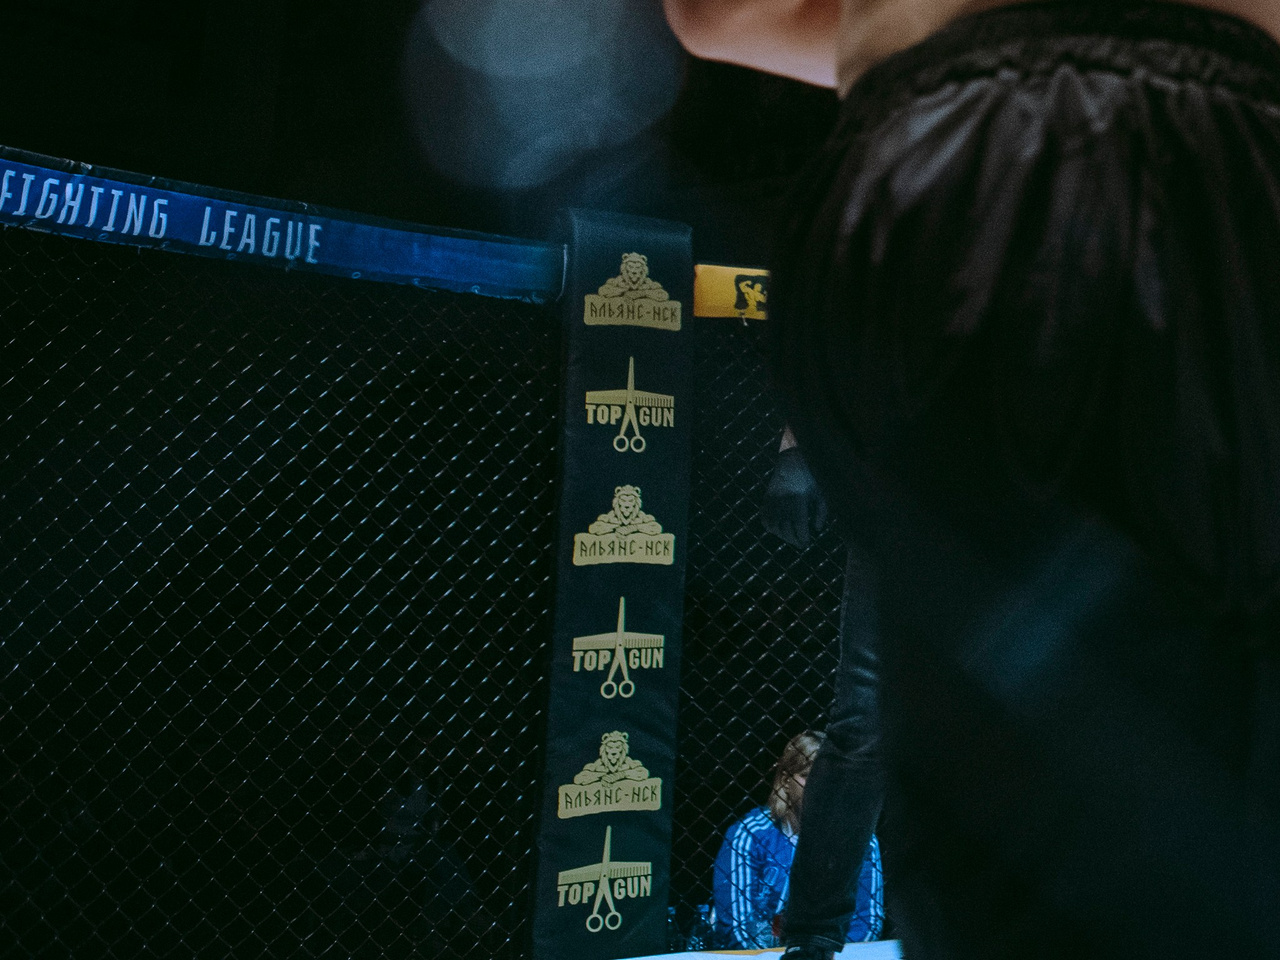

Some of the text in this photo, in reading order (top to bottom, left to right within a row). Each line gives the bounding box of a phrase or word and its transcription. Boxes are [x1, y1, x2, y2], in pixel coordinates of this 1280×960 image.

[0, 168, 323, 264] FIGHTING LEAGUE
[585, 403, 675, 428] TOP GUN
[572, 647, 665, 673] TOP GUN
[557, 875, 653, 908] TOP GUN
